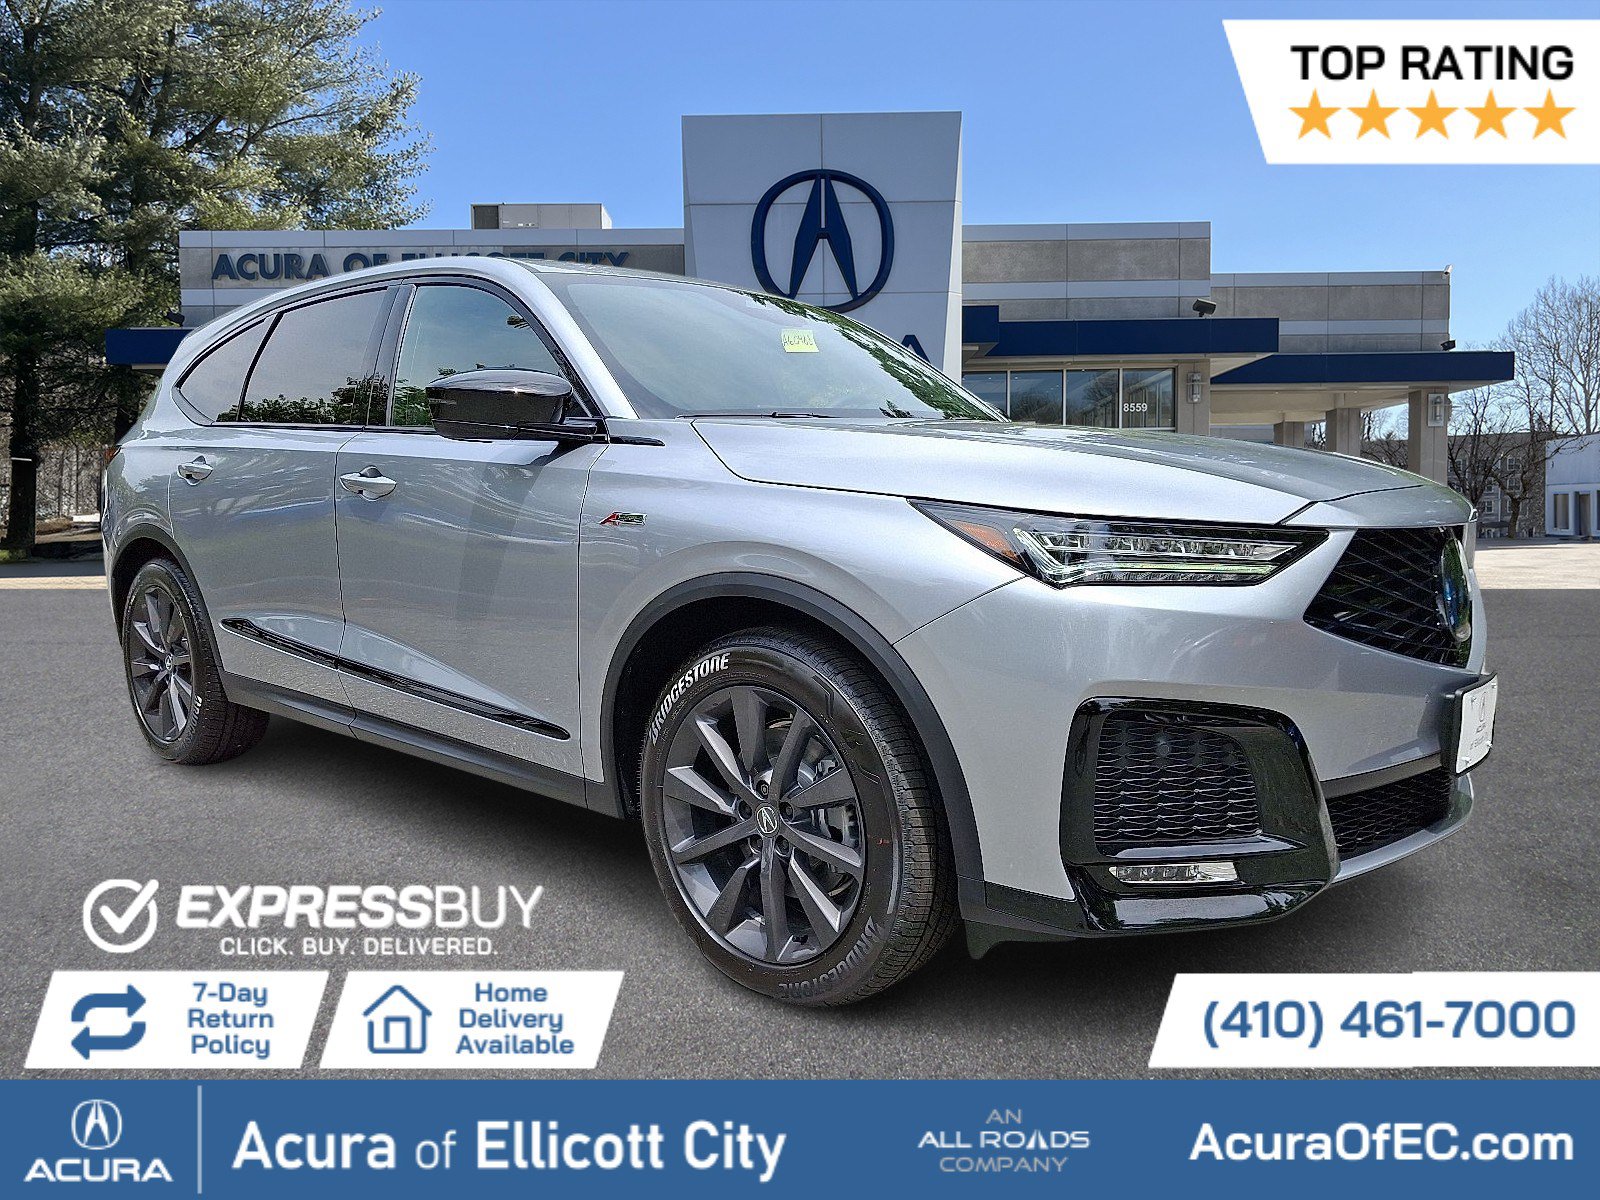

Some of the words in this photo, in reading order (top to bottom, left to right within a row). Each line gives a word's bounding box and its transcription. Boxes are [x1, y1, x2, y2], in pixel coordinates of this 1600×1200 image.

[211, 253, 332, 280] ACURA
[1123, 402, 1148, 412] 8559
[648, 652, 731, 747] BRIDGESTONE
